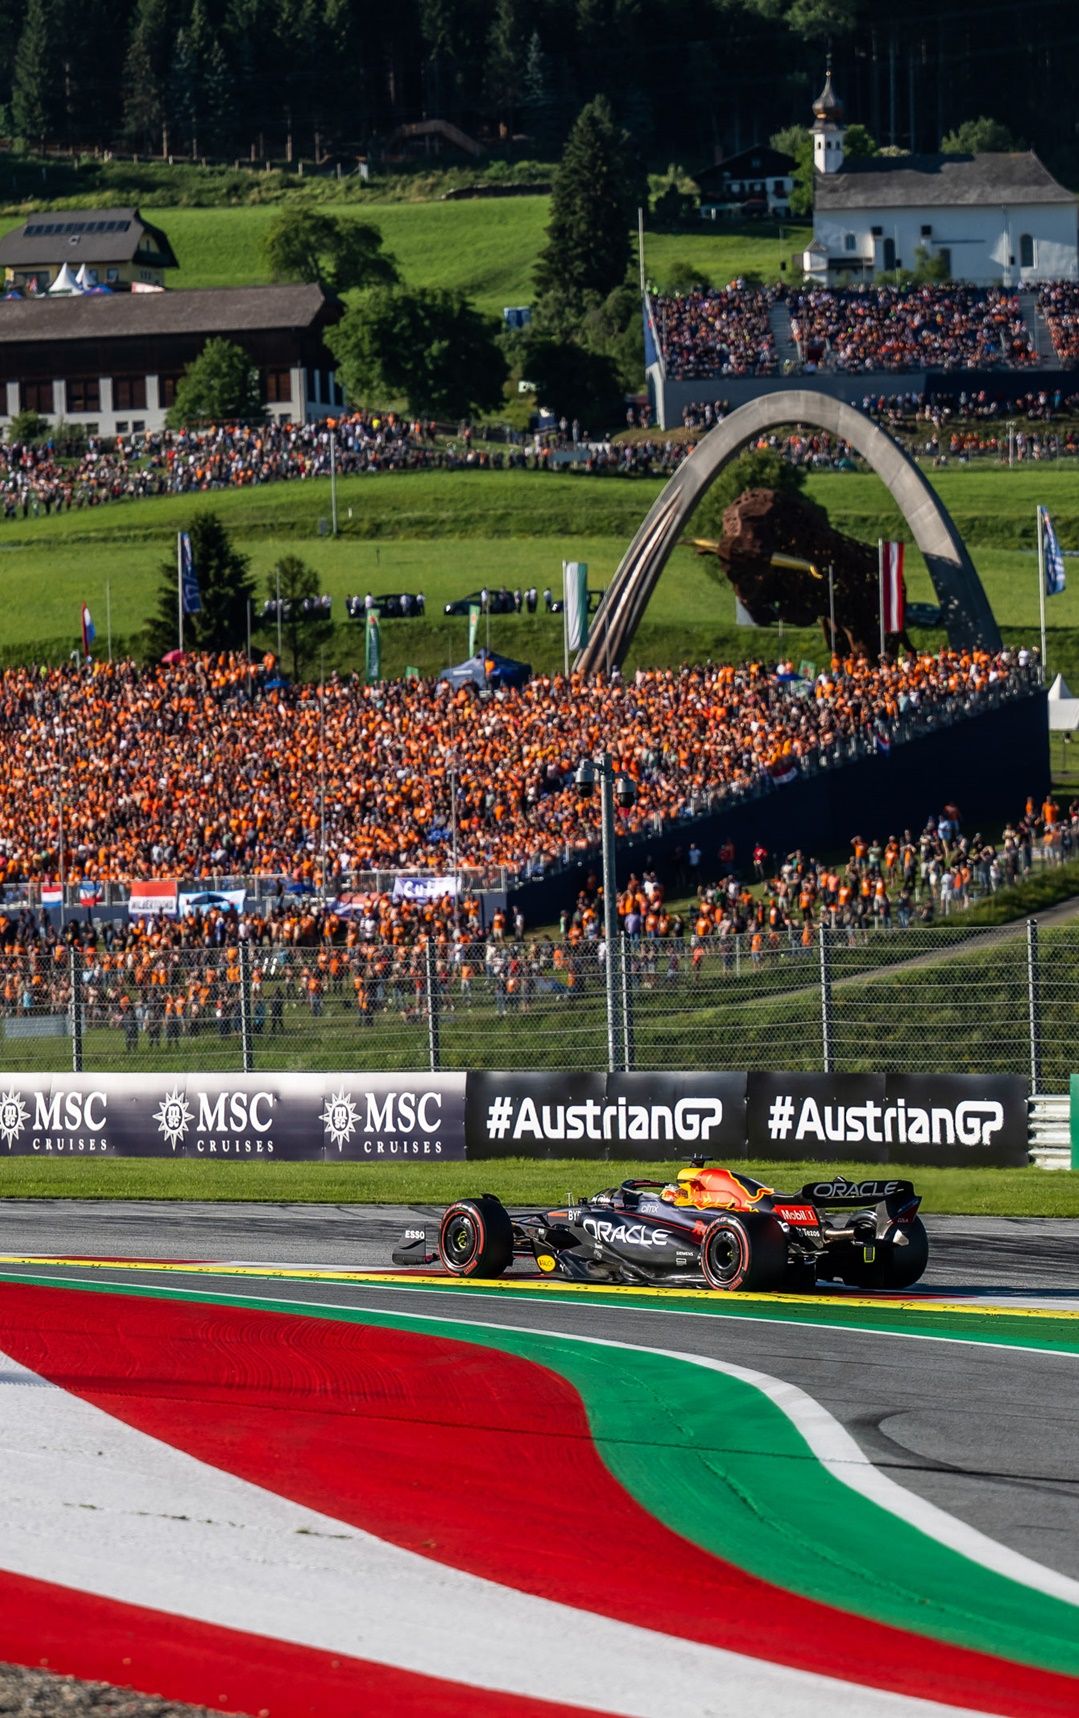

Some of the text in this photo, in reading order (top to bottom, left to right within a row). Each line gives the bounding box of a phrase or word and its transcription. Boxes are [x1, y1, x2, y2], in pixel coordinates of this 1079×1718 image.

[32, 1091, 107, 1131] MSC
[196, 1092, 273, 1132] MSC
[363, 1092, 442, 1133] MSC
[486, 1096, 723, 1141] #AustrianGP
[768, 1096, 1004, 1146] #AustrianGP
[32, 1138, 107, 1151] CRUISES
[197, 1140, 273, 1153] CRUISES
[363, 1141, 442, 1154] CRUISES
[813, 1182, 899, 1197] ORACLE
[780, 1209, 807, 1220] Mobil
[582, 1219, 674, 1246] ORACLE
